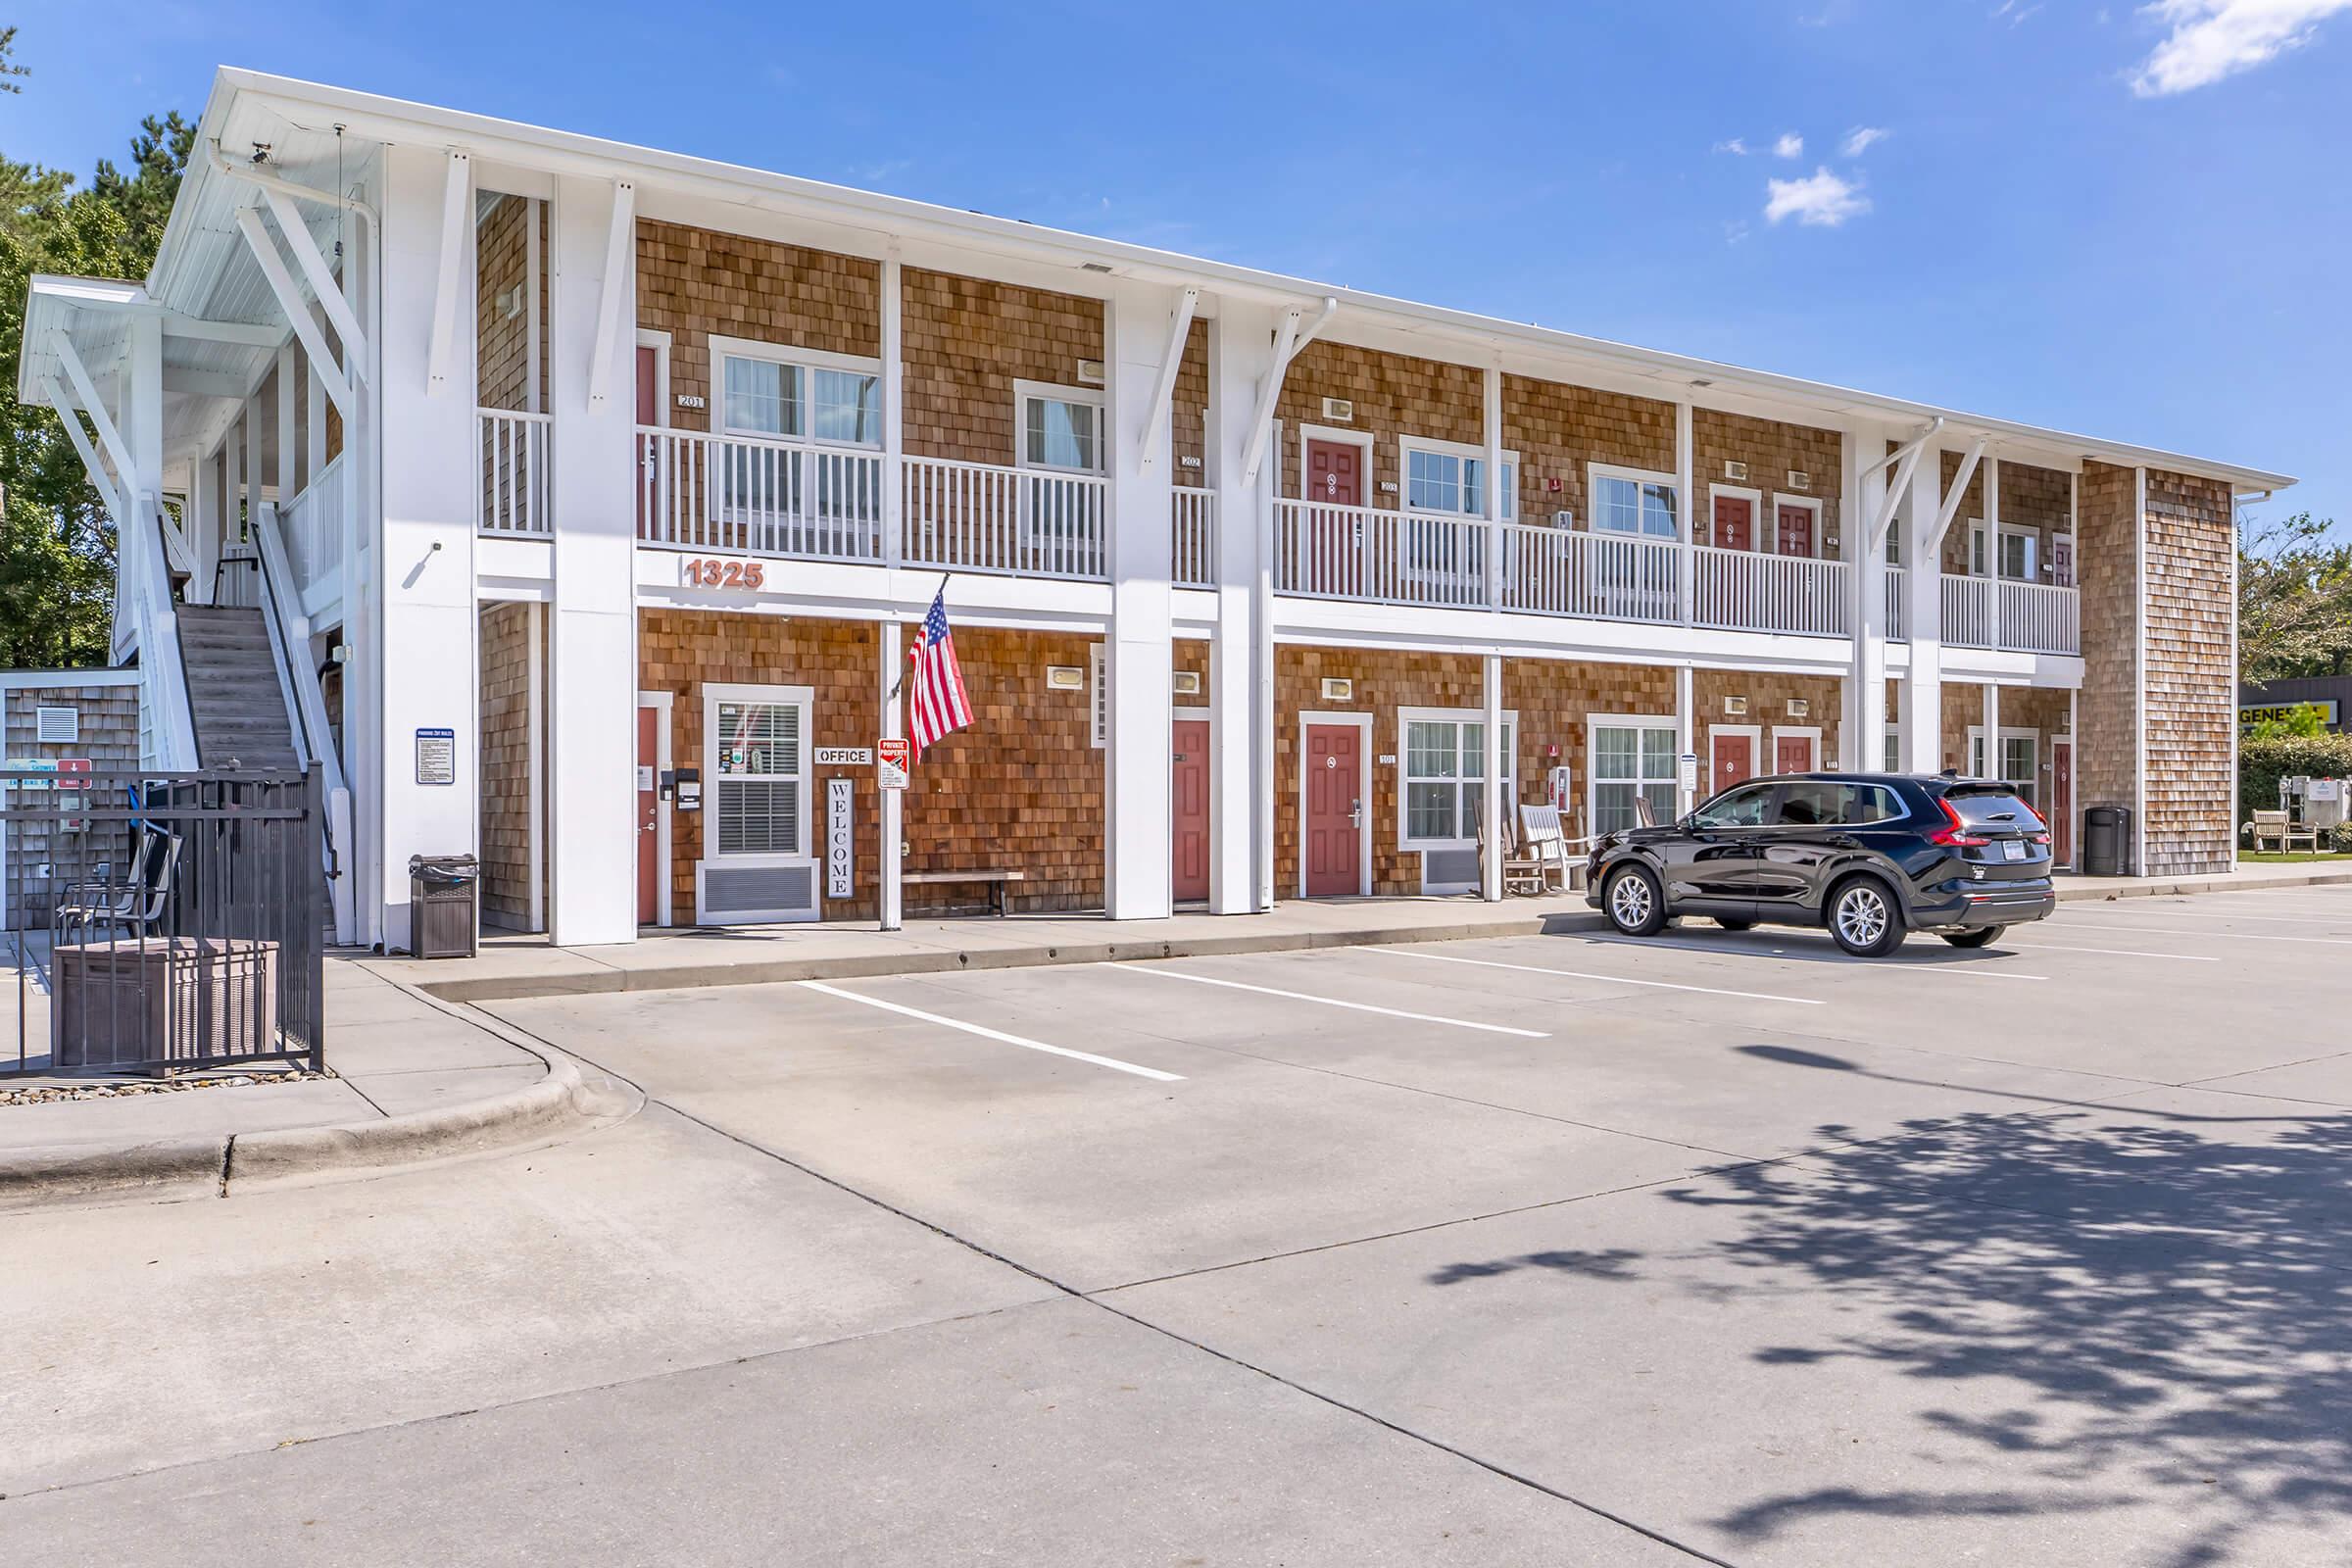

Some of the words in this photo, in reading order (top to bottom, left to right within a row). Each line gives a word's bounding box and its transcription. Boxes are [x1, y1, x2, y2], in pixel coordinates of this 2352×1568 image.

[681, 395, 701, 408] 201
[1183, 456, 1200, 466] 202
[686, 559, 763, 588] 1325
[820, 750, 866, 762] OFFICE
[832, 784, 848, 893] WELCOME
